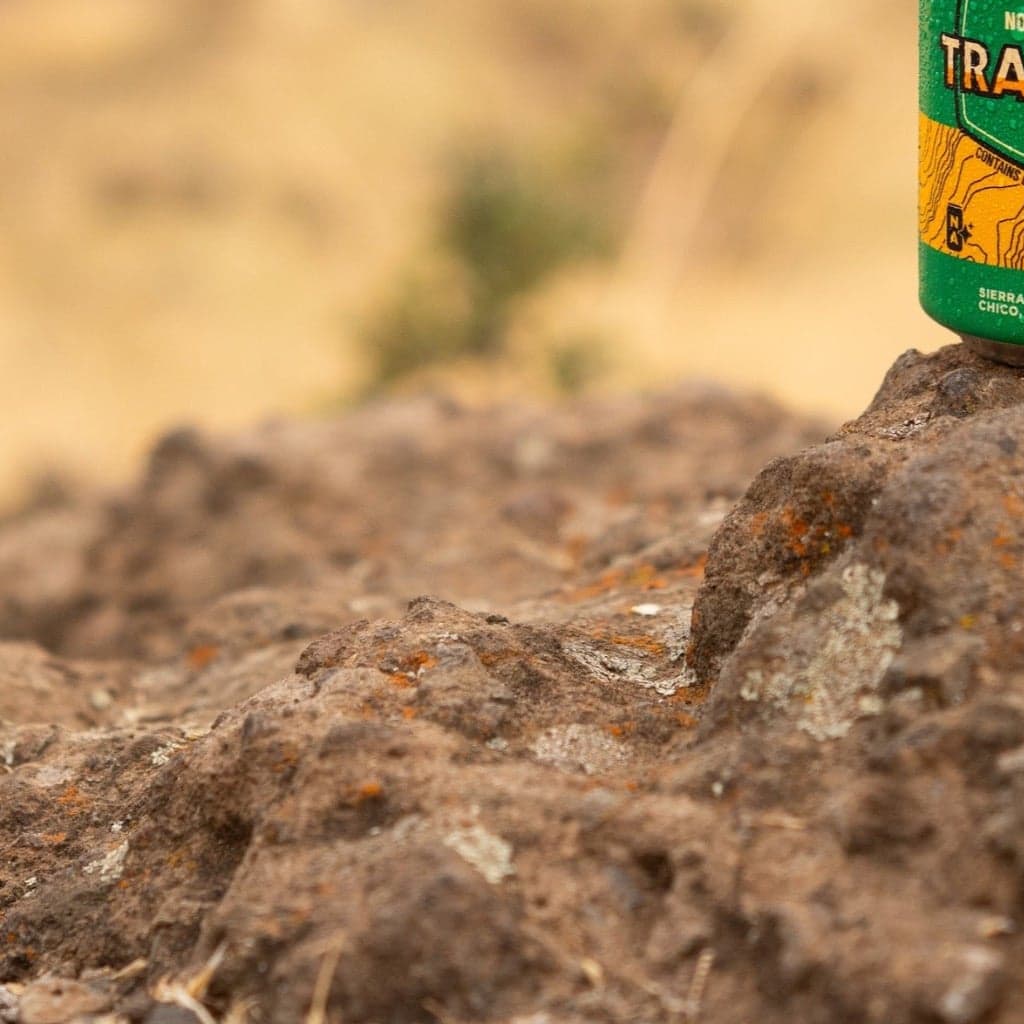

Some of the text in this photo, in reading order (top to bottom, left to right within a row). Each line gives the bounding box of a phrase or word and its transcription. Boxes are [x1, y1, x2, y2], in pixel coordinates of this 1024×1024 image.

[975, 147, 1020, 182] CONTAINS
[979, 287, 1024, 305] SIERRA
[978, 300, 1023, 318] CHICO,
